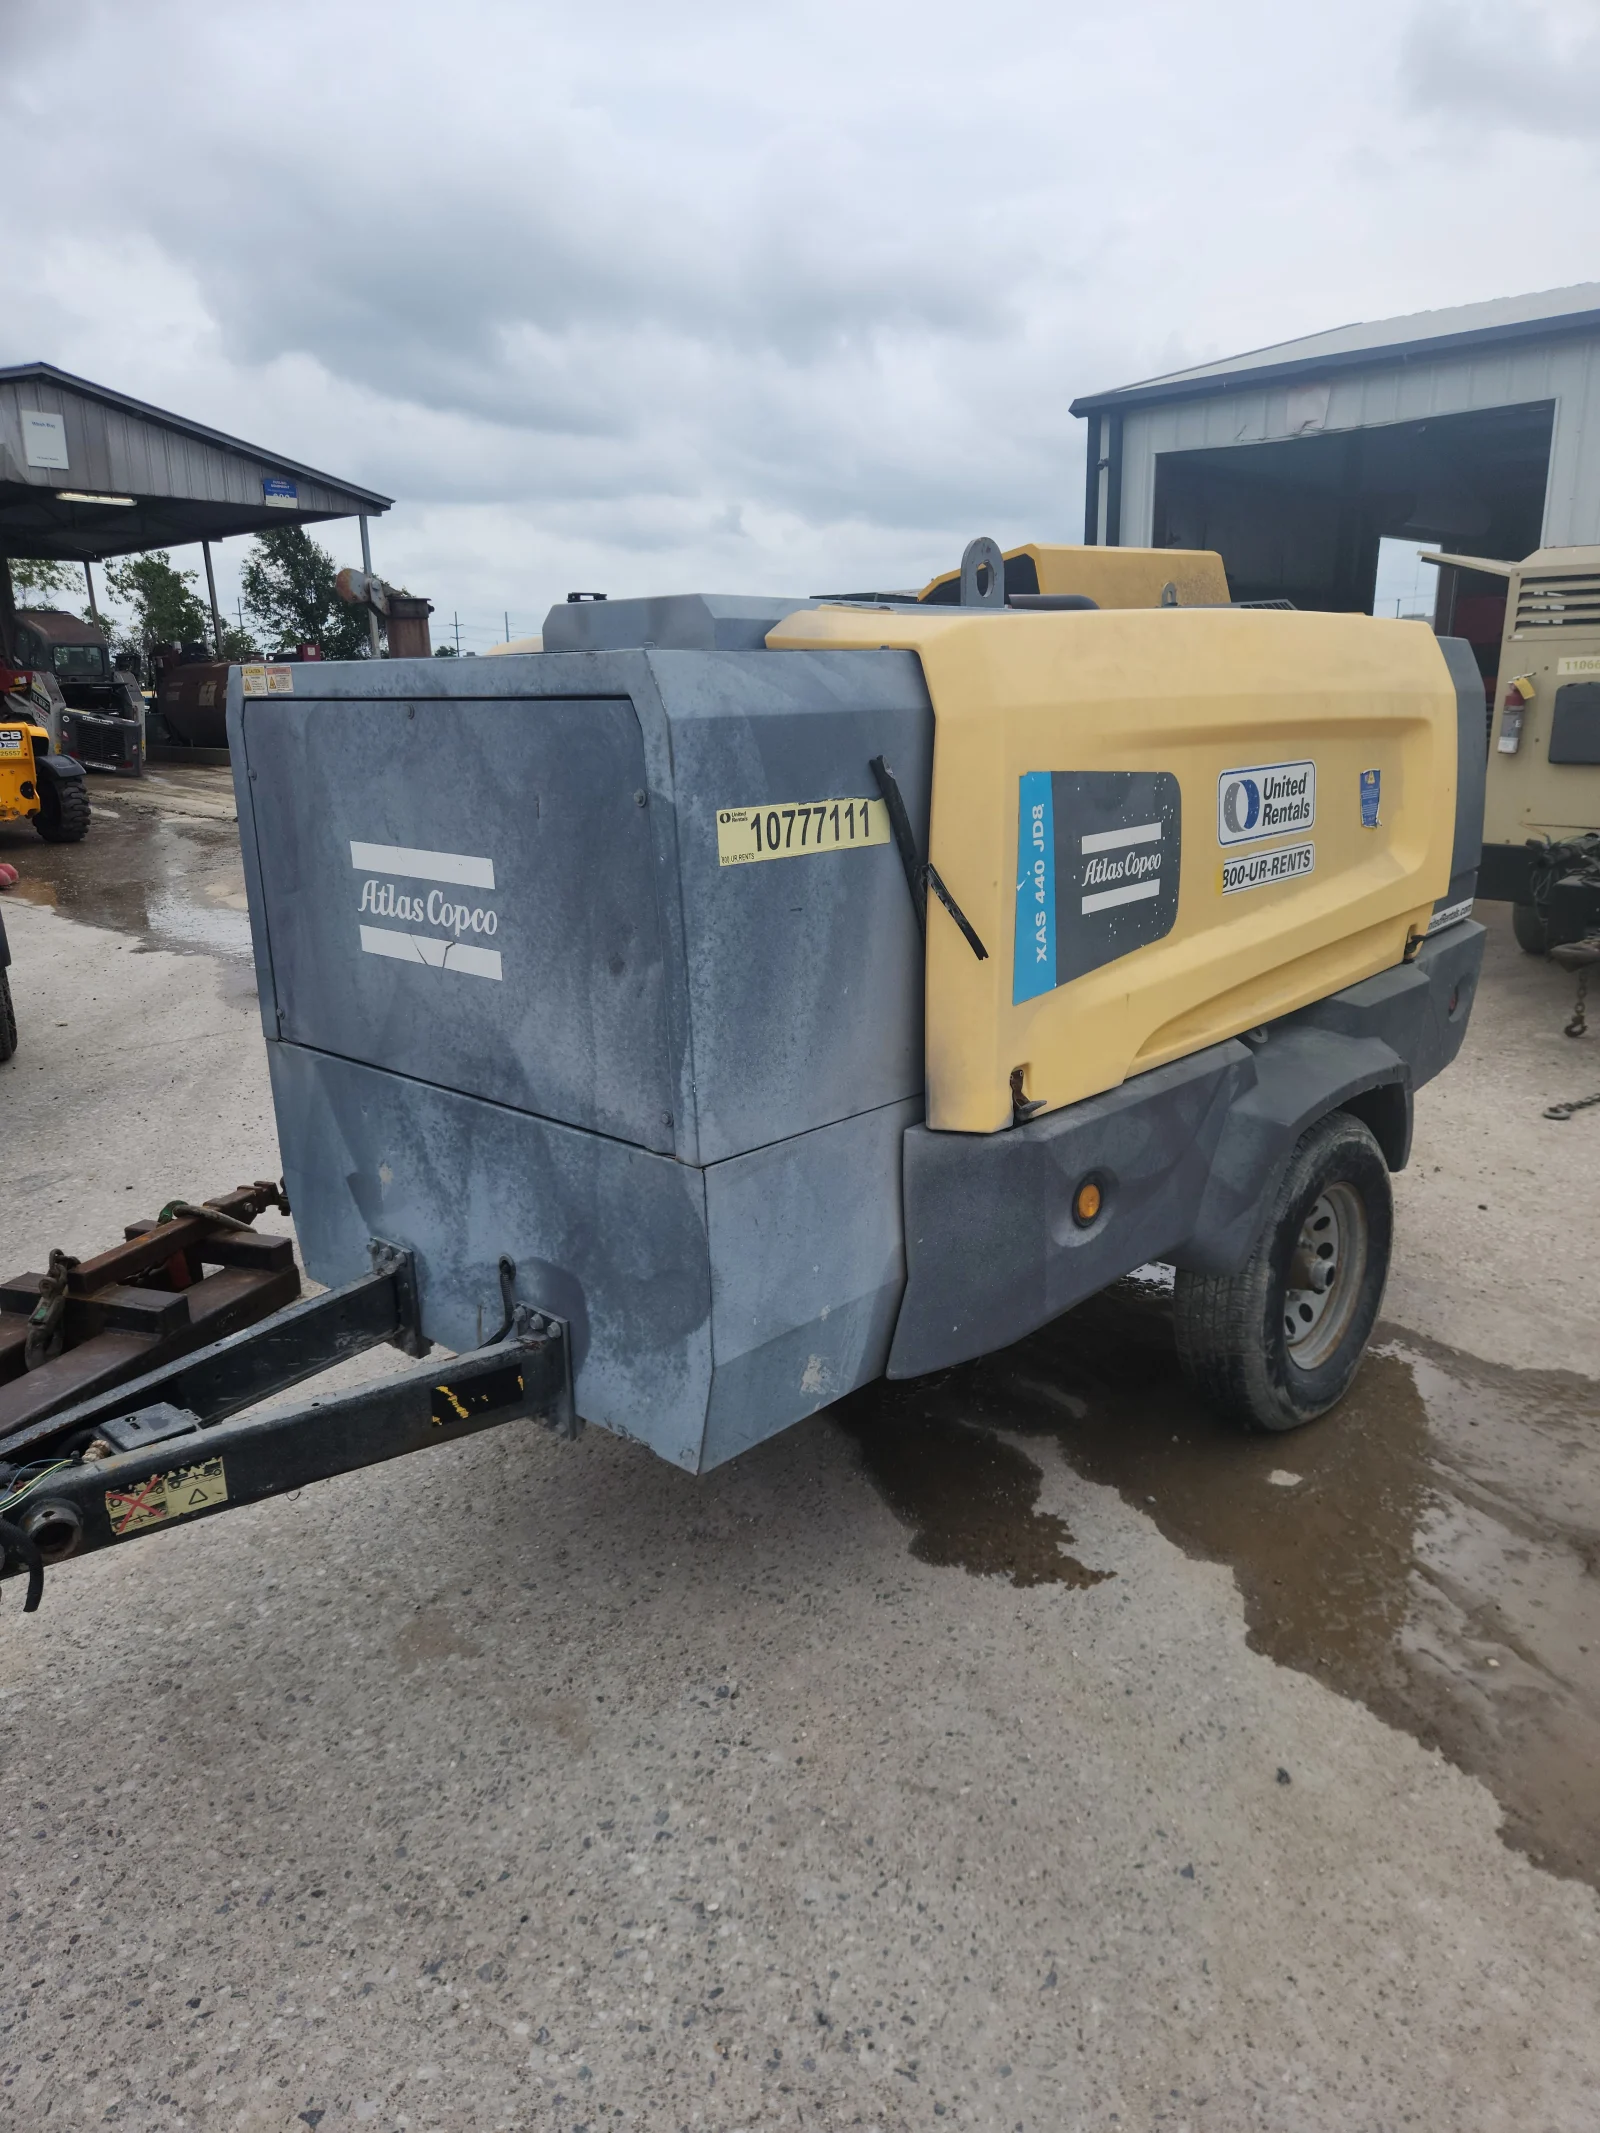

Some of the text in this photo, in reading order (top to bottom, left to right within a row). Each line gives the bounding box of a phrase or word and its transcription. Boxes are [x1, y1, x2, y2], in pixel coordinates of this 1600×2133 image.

[0, 731, 21, 740] CB
[1263, 772, 1308, 801] United
[750, 801, 870, 852] 10777111
[1261, 797, 1311, 827] Rentals
[1032, 804, 1048, 963] XAS 440 JD8
[1081, 851, 1162, 887] Atlas Copco
[357, 879, 498, 937] Atlas Copco
[1428, 904, 1472, 931] nitedRentals.com
